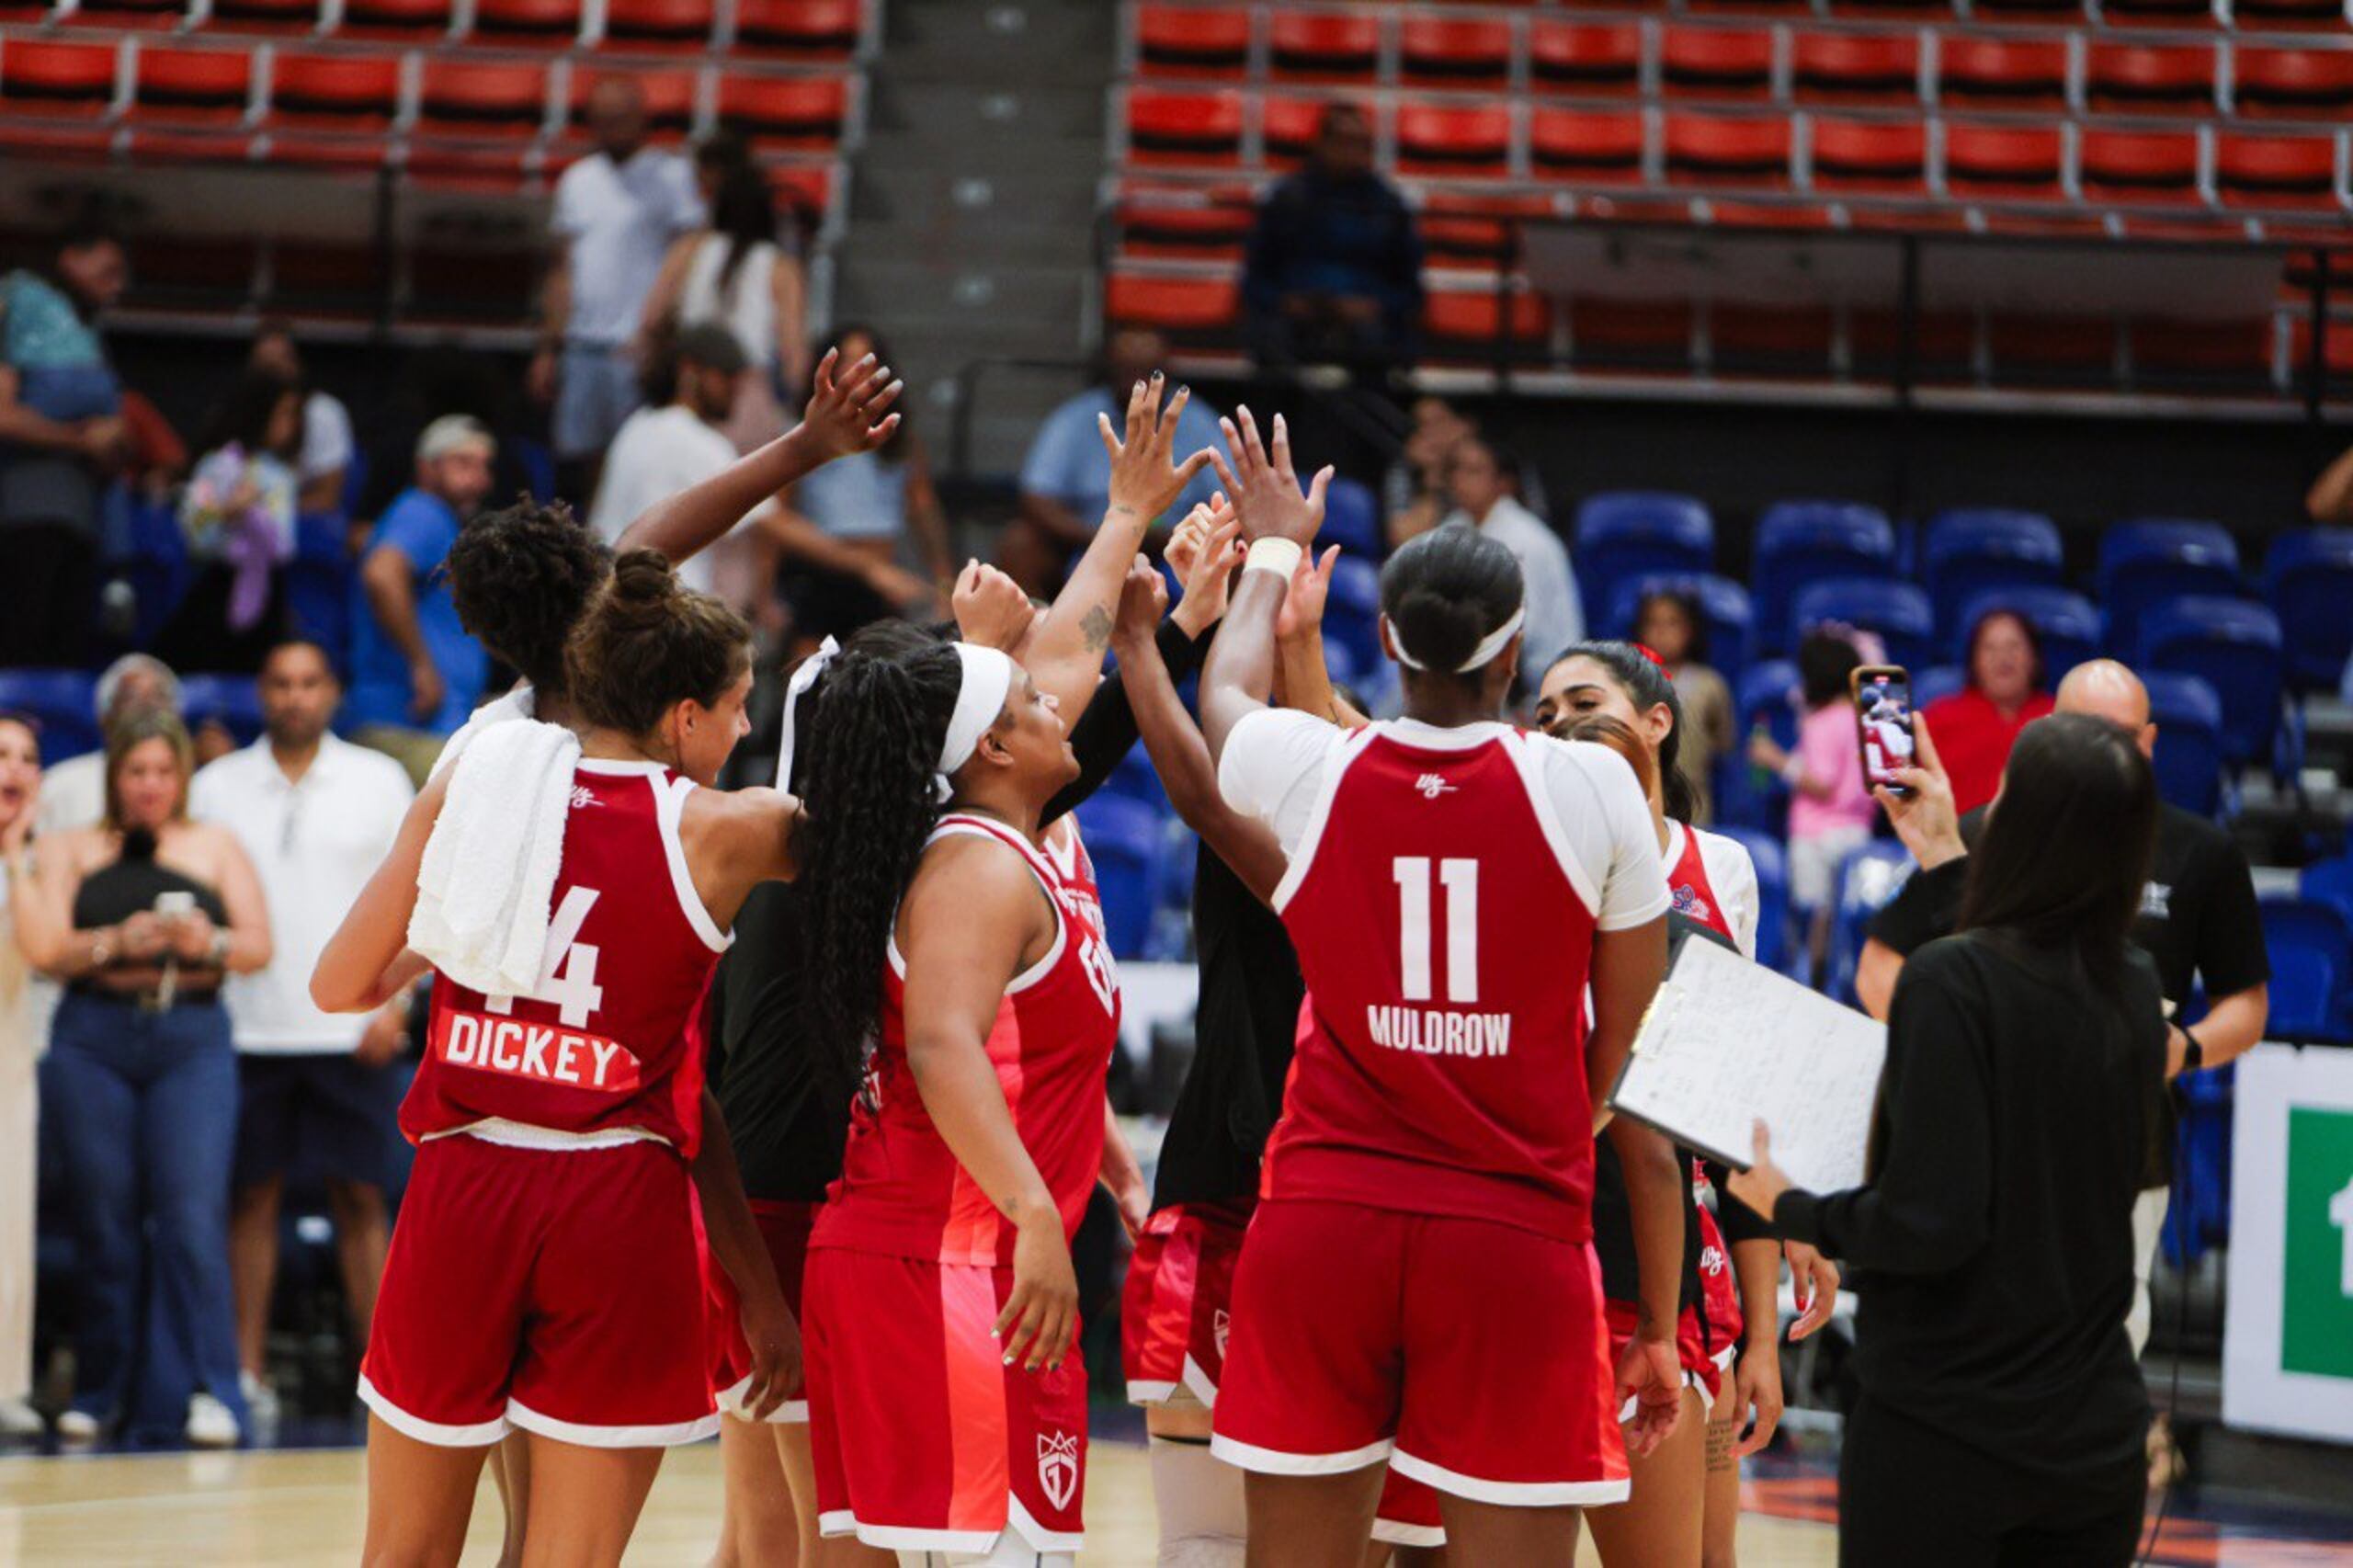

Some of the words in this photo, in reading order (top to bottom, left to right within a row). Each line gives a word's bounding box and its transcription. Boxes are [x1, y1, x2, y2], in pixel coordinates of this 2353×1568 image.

[484, 885, 602, 1028] 4
[1392, 856, 1479, 1003] 11
[447, 1015, 619, 1086] DICKEY
[1367, 1005, 1511, 1058] MULDROW
